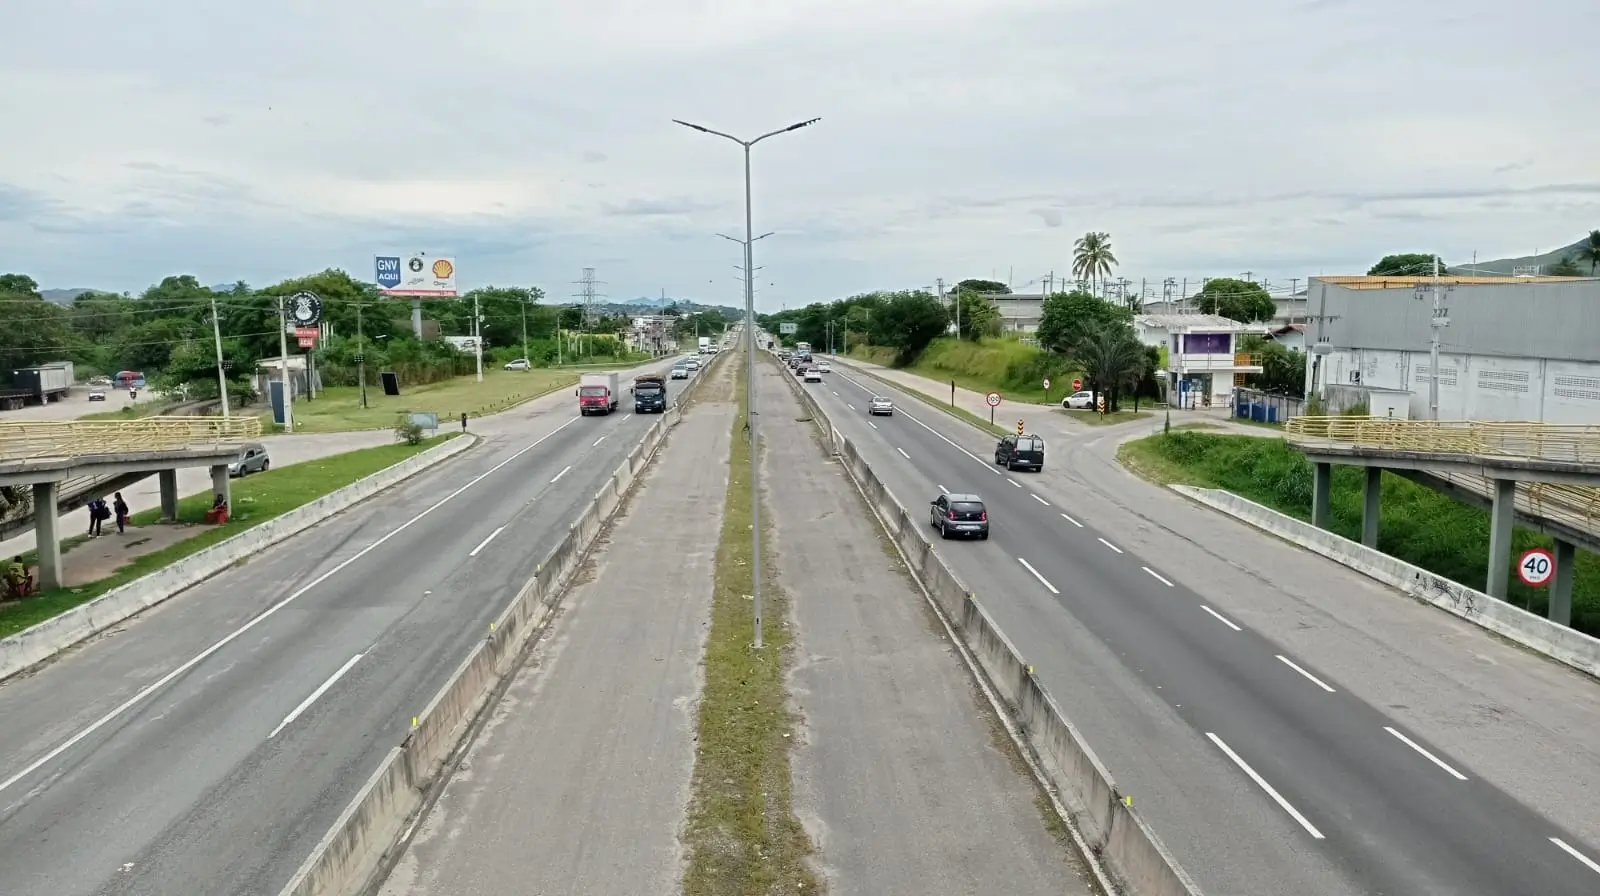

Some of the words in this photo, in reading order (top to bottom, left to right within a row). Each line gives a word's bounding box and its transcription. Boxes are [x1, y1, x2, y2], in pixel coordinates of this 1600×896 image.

[377, 260, 398, 271] GNV
[378, 273, 399, 281] AQUI
[1524, 557, 1549, 574] 40
